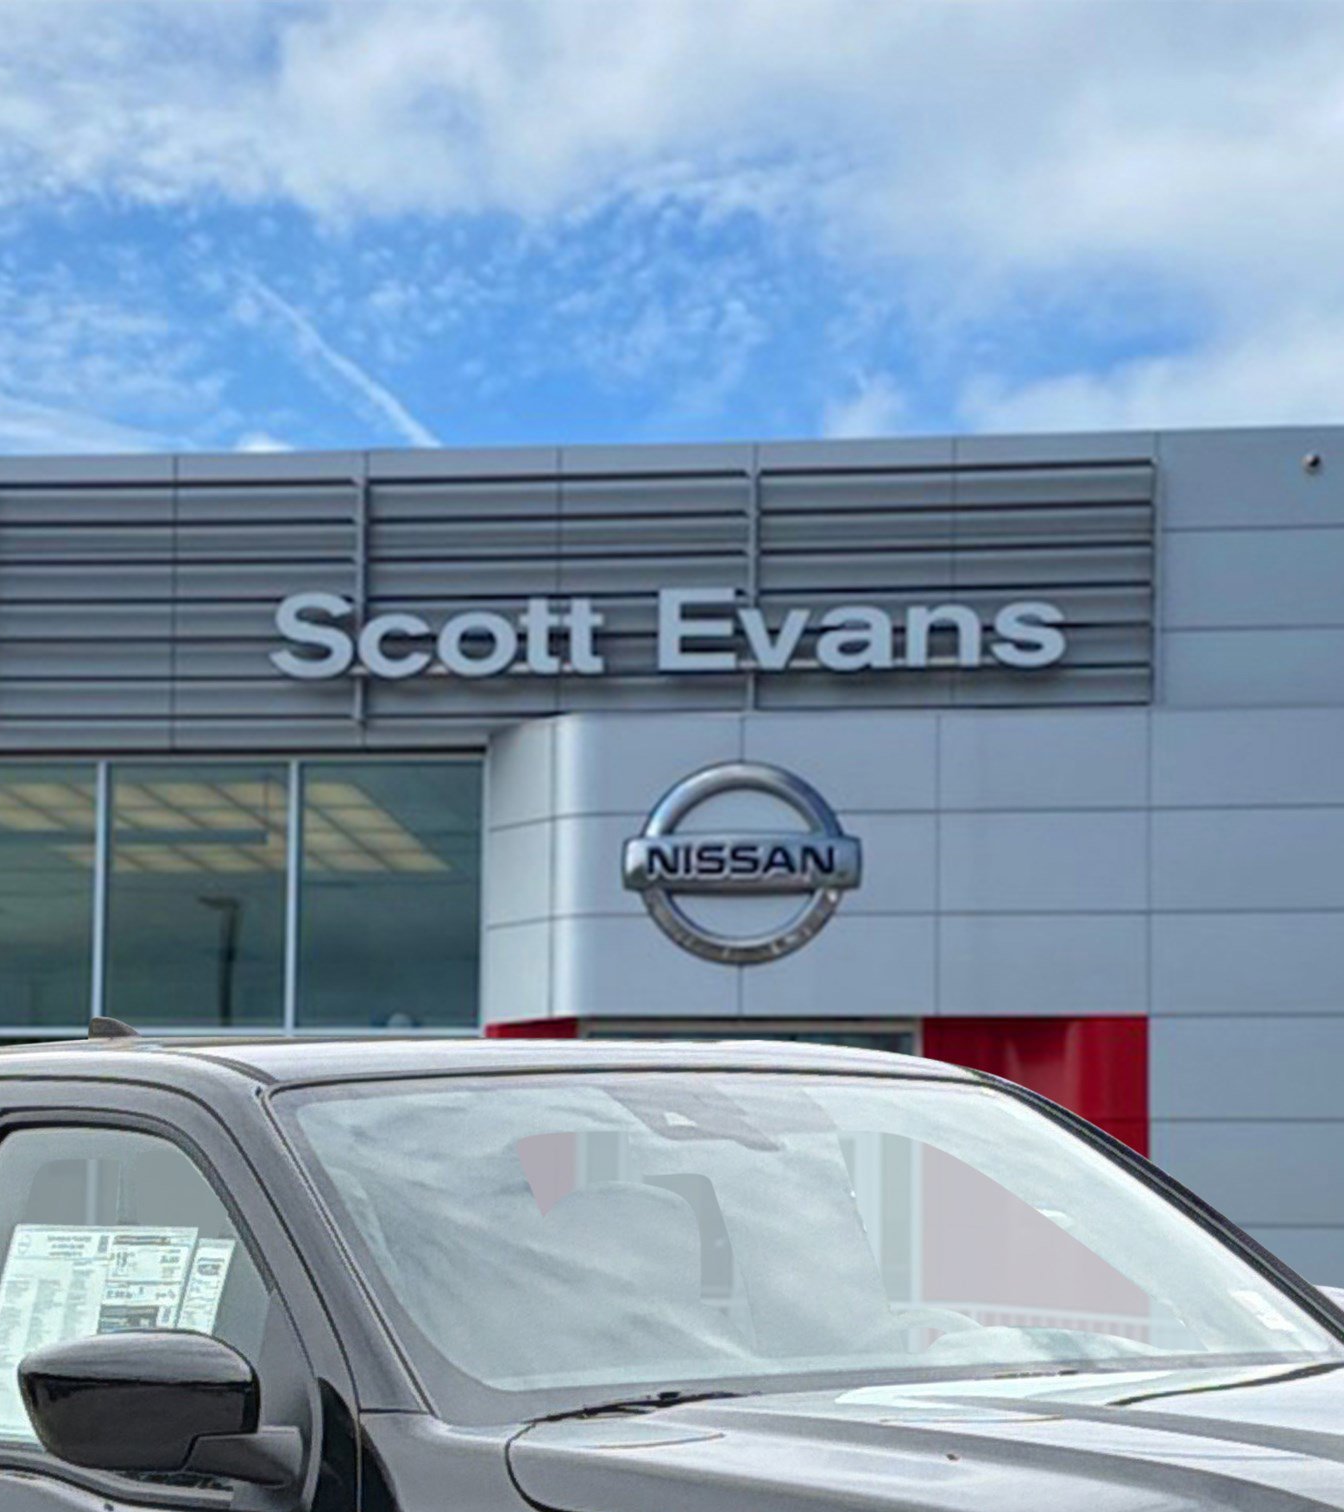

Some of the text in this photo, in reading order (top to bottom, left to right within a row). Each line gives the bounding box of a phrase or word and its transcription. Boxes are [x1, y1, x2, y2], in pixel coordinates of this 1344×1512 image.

[270, 587, 1069, 679] Scott Evans
[646, 845, 836, 876] NISSAN
